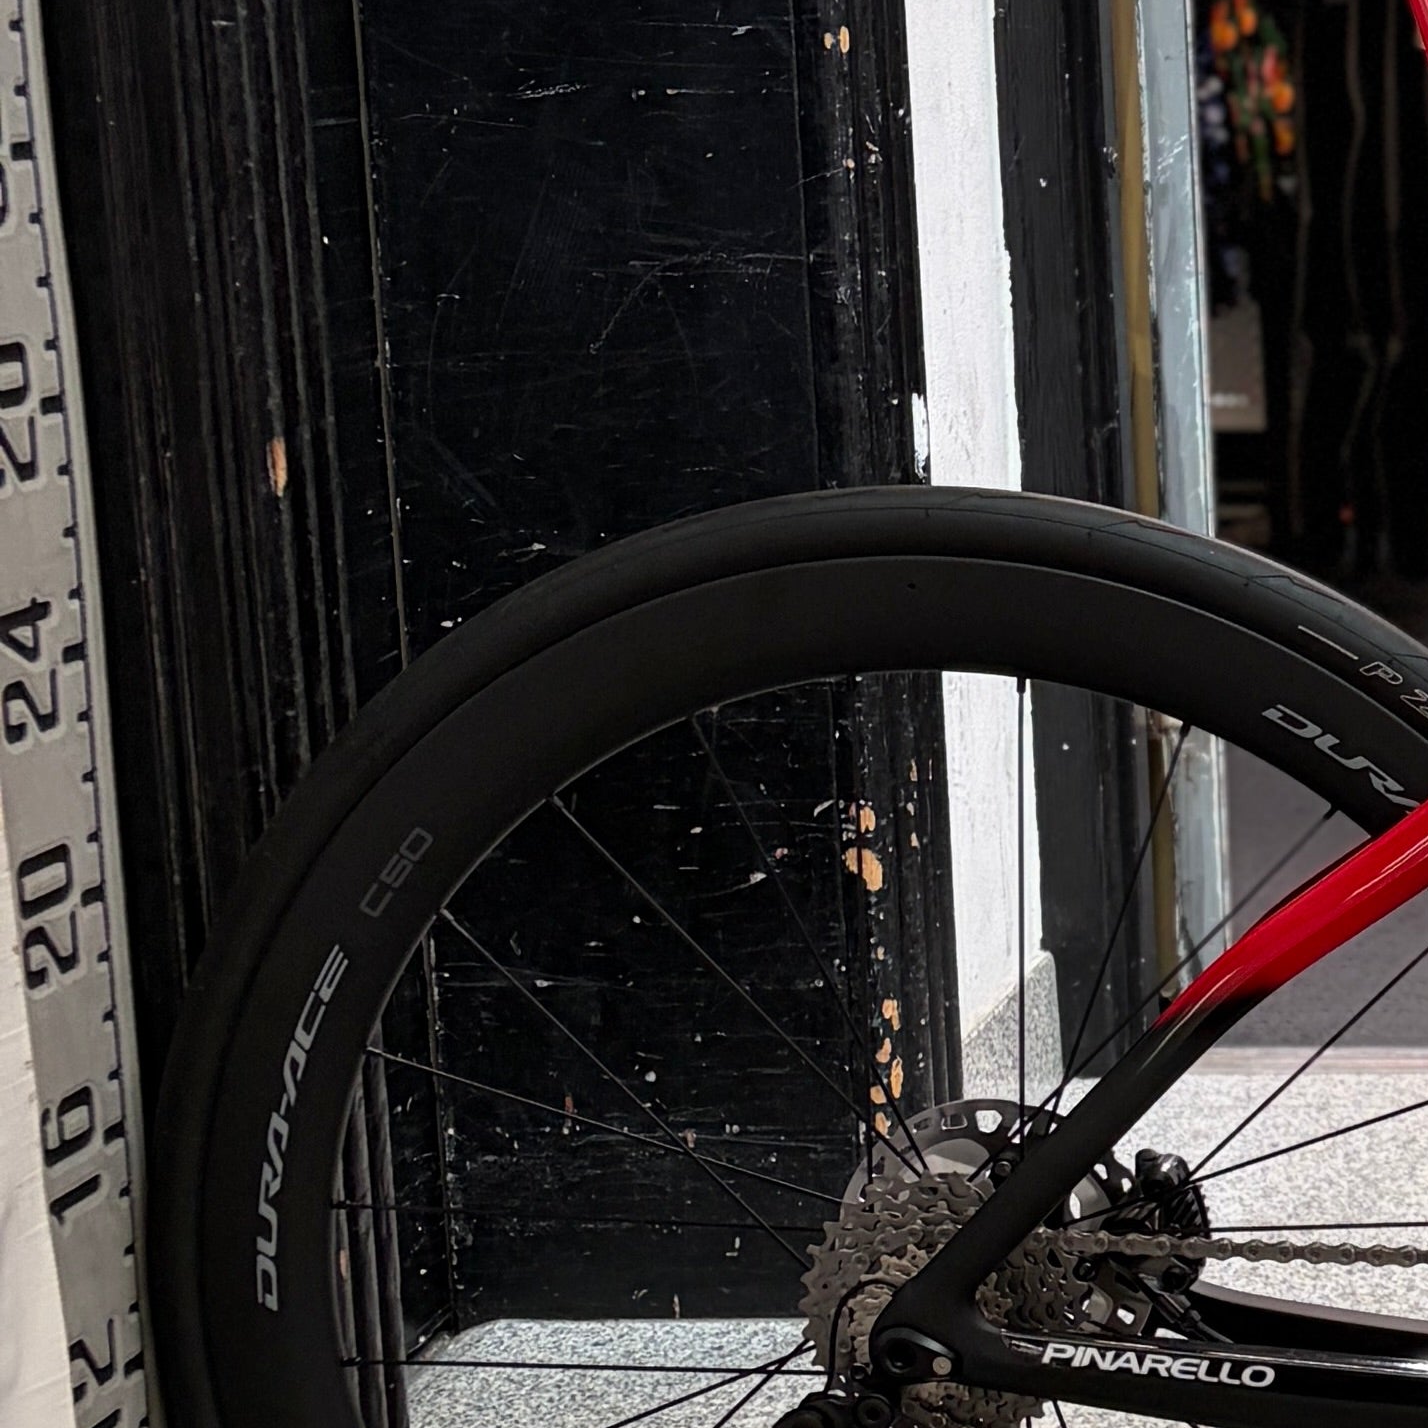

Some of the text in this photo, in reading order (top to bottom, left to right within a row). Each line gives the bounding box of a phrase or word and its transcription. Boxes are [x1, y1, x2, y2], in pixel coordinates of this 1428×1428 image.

[2, 598, 60, 745] 24
[17, 842, 80, 990] 20
[256, 827, 433, 1311] DURA-ACE C50
[1042, 1342, 1275, 1388] PINARELLO
